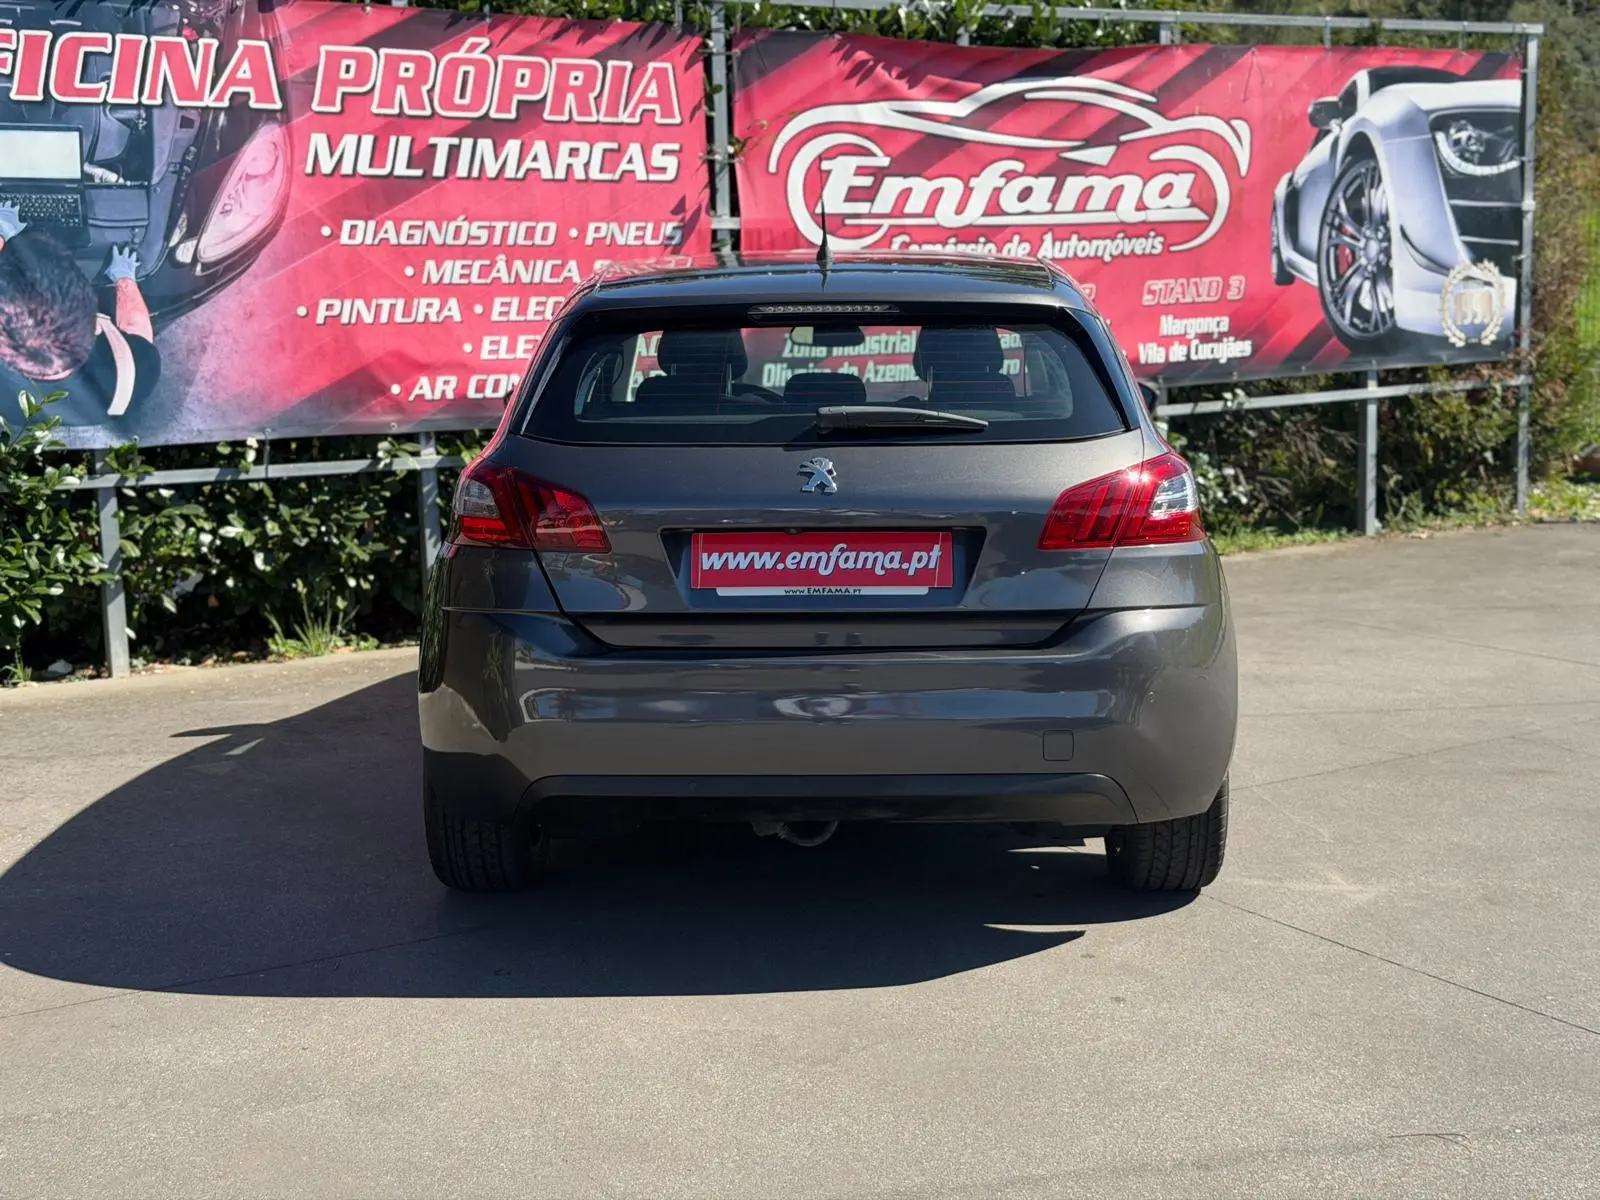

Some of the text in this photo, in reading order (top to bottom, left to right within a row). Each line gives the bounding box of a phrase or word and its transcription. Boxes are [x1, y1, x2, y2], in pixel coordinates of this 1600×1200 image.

[311, 37, 682, 125] PRÓPRIA
[304, 132, 682, 182] MULTIMARCAS
[814, 154, 1194, 229] Emfama
[339, 214, 683, 247] DIAGNÓSTICO PNEUS
[1001, 233, 1032, 258] de
[1036, 230, 1164, 263] Automóveis
[421, 254, 582, 285] MECÂNICA
[1142, 275, 1246, 306] STAND 3
[315, 297, 462, 326] PINTURA
[1159, 314, 1230, 340] Margonça
[480, 333, 543, 361] ELE
[1137, 342, 1166, 365] Vila
[1168, 340, 1189, 362] de
[408, 375, 458, 402] AR
[701, 543, 942, 576] www.emfama.pt
